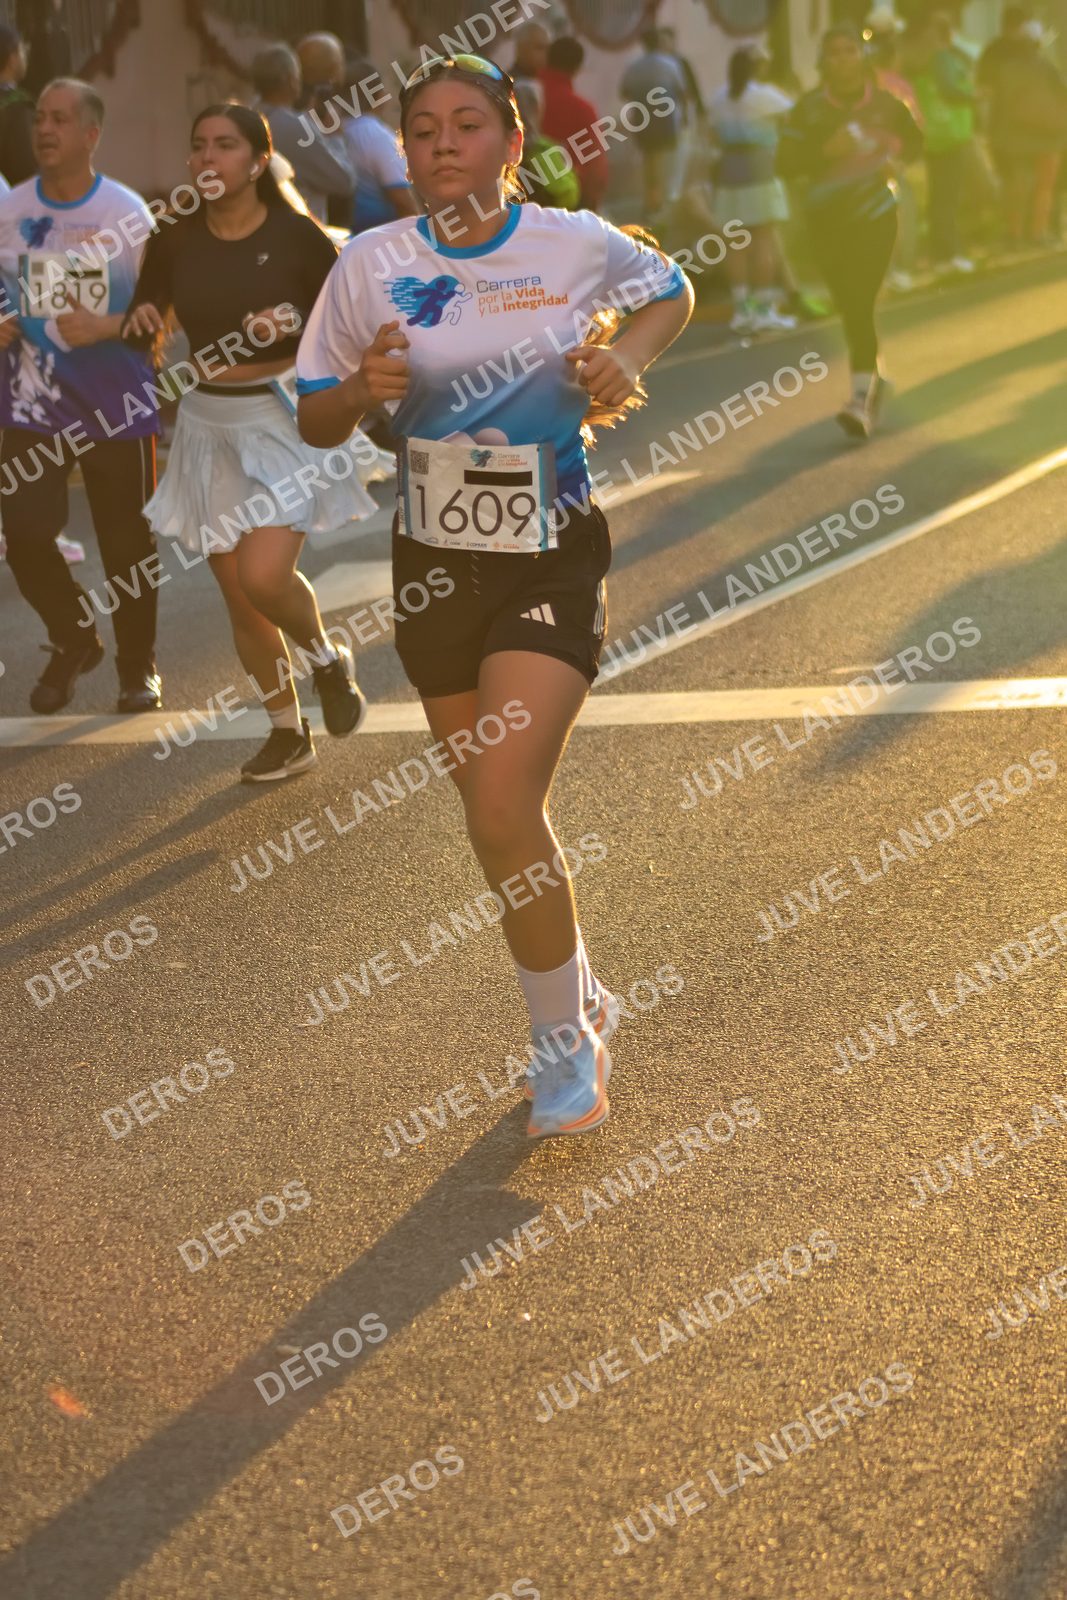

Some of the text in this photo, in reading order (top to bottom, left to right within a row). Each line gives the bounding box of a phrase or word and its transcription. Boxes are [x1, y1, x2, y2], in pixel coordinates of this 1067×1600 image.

[35, 282, 107, 310] 1819
[476, 276, 541, 293] Carrera
[478, 287, 544, 306] por la Vida
[478, 293, 568, 317] y la Integridad
[416, 484, 536, 538] 1609
